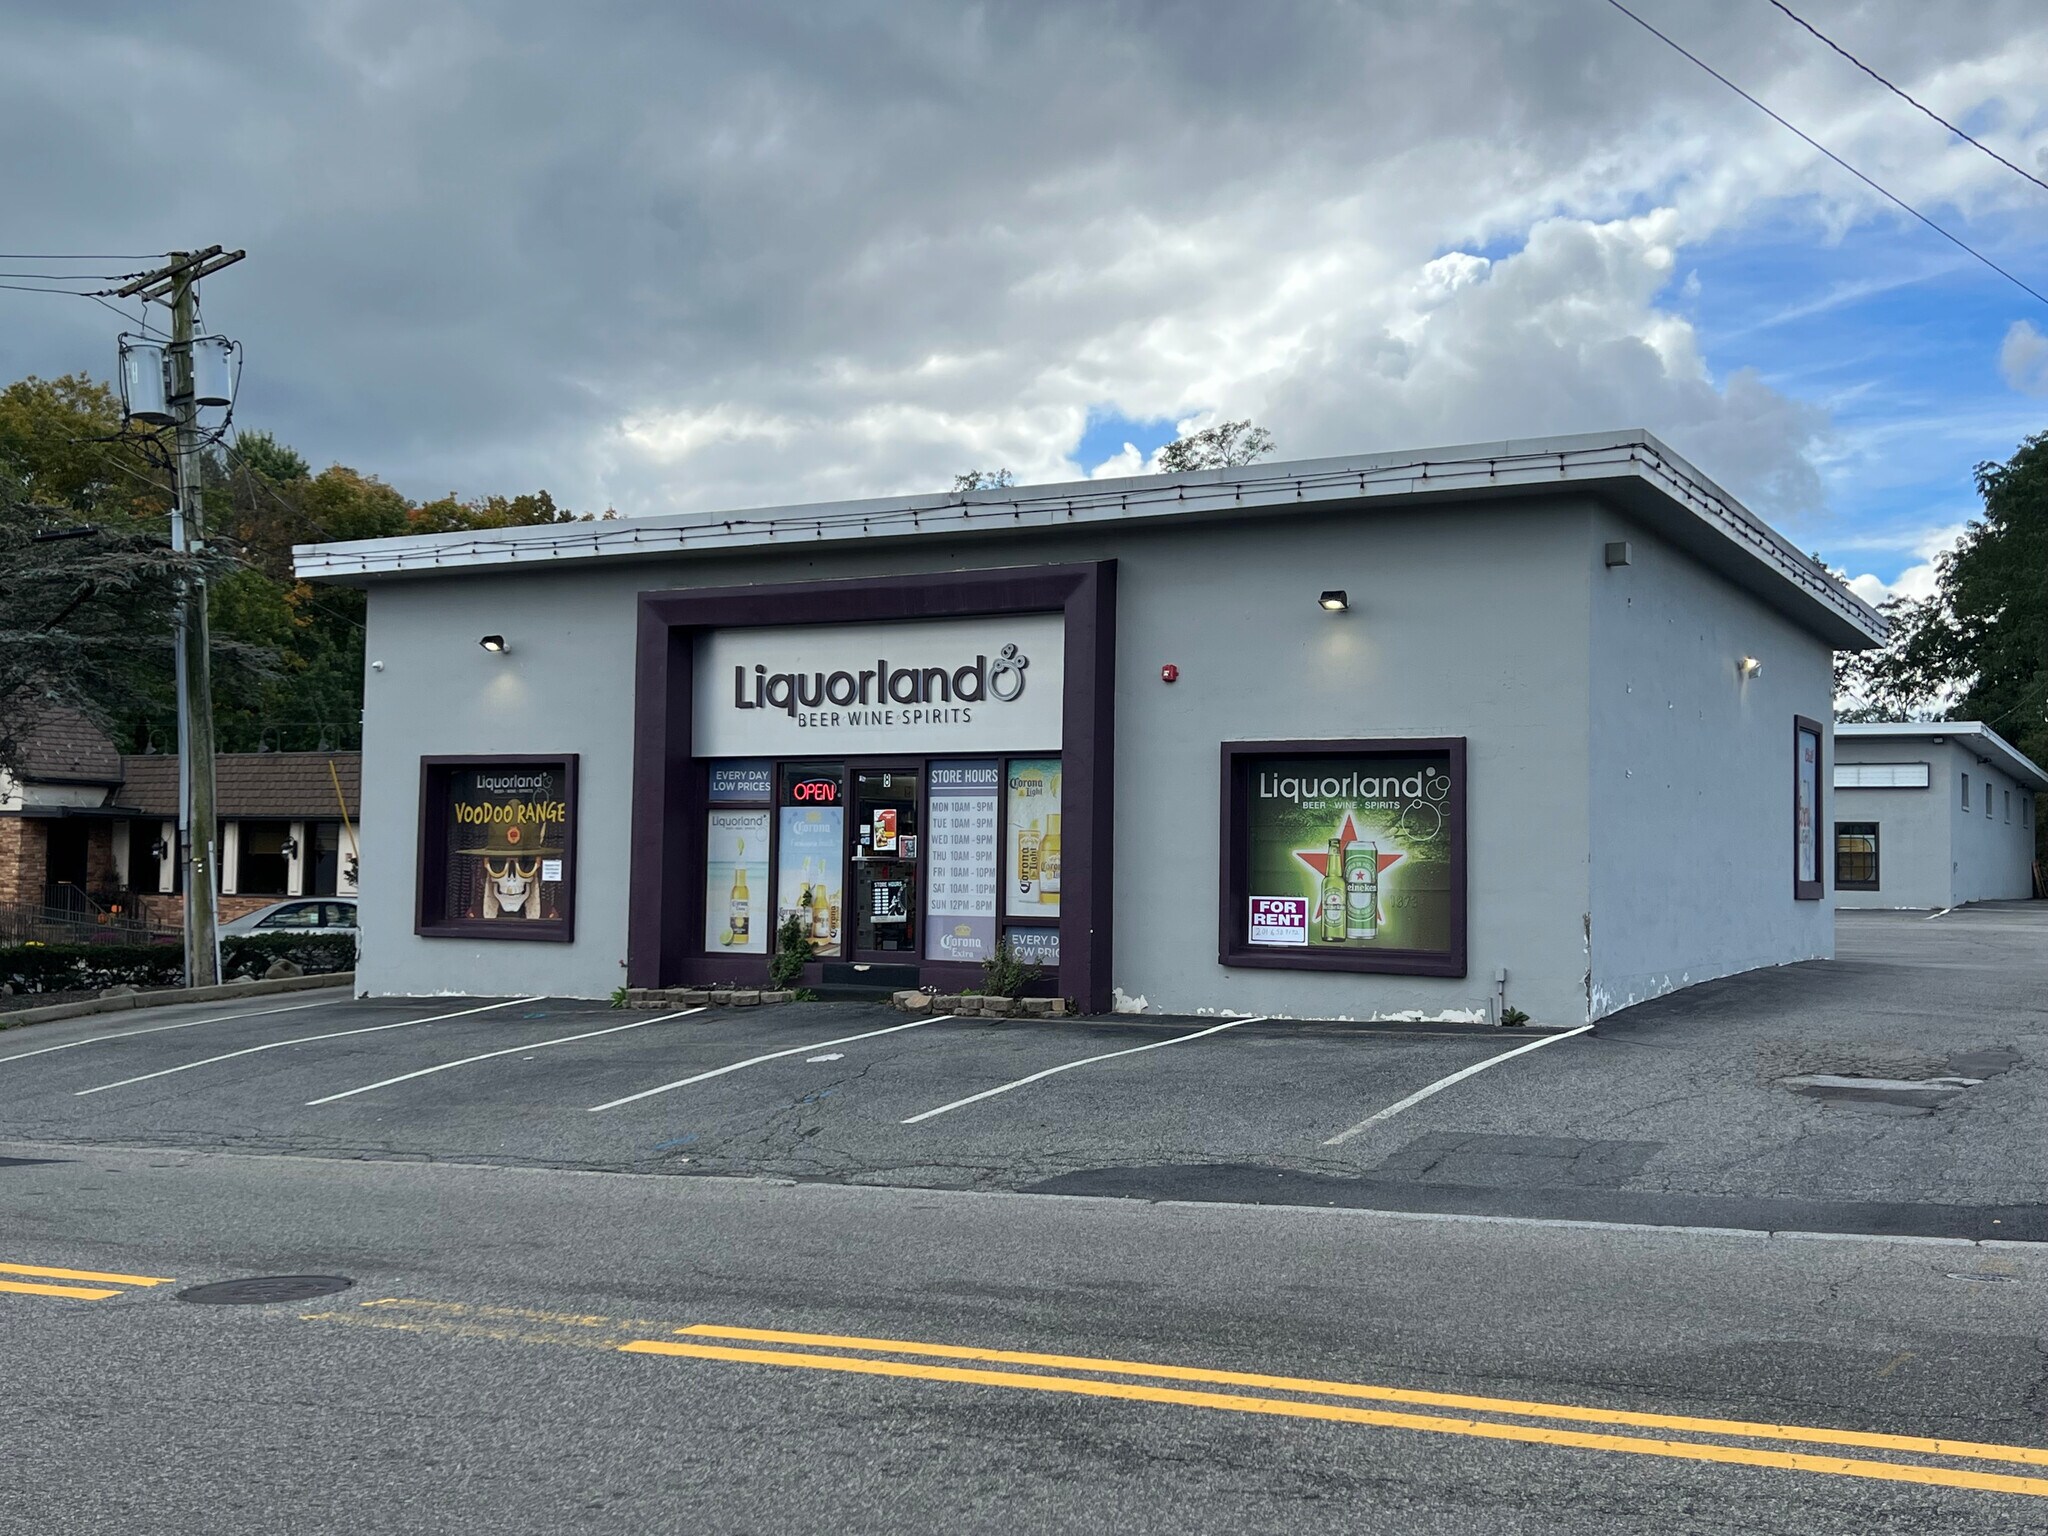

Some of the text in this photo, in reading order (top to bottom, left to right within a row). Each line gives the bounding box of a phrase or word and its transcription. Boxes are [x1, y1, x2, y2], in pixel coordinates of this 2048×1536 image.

[734, 654, 986, 718] Liquorland
[798, 708, 972, 728] BEER WINE SPIRITS
[716, 770, 768, 780] EVERY DAY
[932, 769, 998, 784] STORE HOURS
[476, 774, 542, 791] Liquorland
[713, 781, 770, 791] LOW PRICES
[1010, 777, 1043, 790] Corona
[1260, 771, 1422, 803] Liquorland
[794, 783, 835, 801] OPEN
[1026, 788, 1042, 797] Light
[932, 802, 948, 812] MON
[951, 802, 970, 812] 10AM
[977, 802, 993, 812] 9PM
[1334, 801, 1357, 809] WINE
[1365, 801, 1400, 809] SPIRITS
[455, 802, 565, 824] VOODOO RANGE
[712, 816, 763, 829] Liquorland
[933, 818, 947, 828] TUE
[951, 818, 970, 828] 10AM
[977, 818, 993, 828] 9PM
[932, 835, 948, 845] WED
[951, 835, 970, 845] 10AM
[976, 835, 992, 844] 9PM
[933, 851, 946, 861] THU
[950, 851, 969, 861] 10AM
[976, 851, 992, 860] 9PM
[933, 867, 945, 877] FRI
[950, 867, 969, 877] 10AM
[976, 867, 995, 877] 10PM
[1020, 847, 1032, 893] Corona
[933, 884, 945, 893] SAT
[950, 884, 969, 893] 10AM
[976, 884, 995, 894] 10PM
[932, 900, 946, 910] SUN
[950, 900, 969, 910] 12PM
[976, 901, 992, 910] 8PM
[1260, 901, 1296, 913] FOR
[1254, 914, 1303, 926] RENT
[940, 933, 981, 949] Corona
[1012, 935, 1048, 945] EVERY
[952, 948, 974, 958] Extra
[1014, 946, 1035, 956] OW
